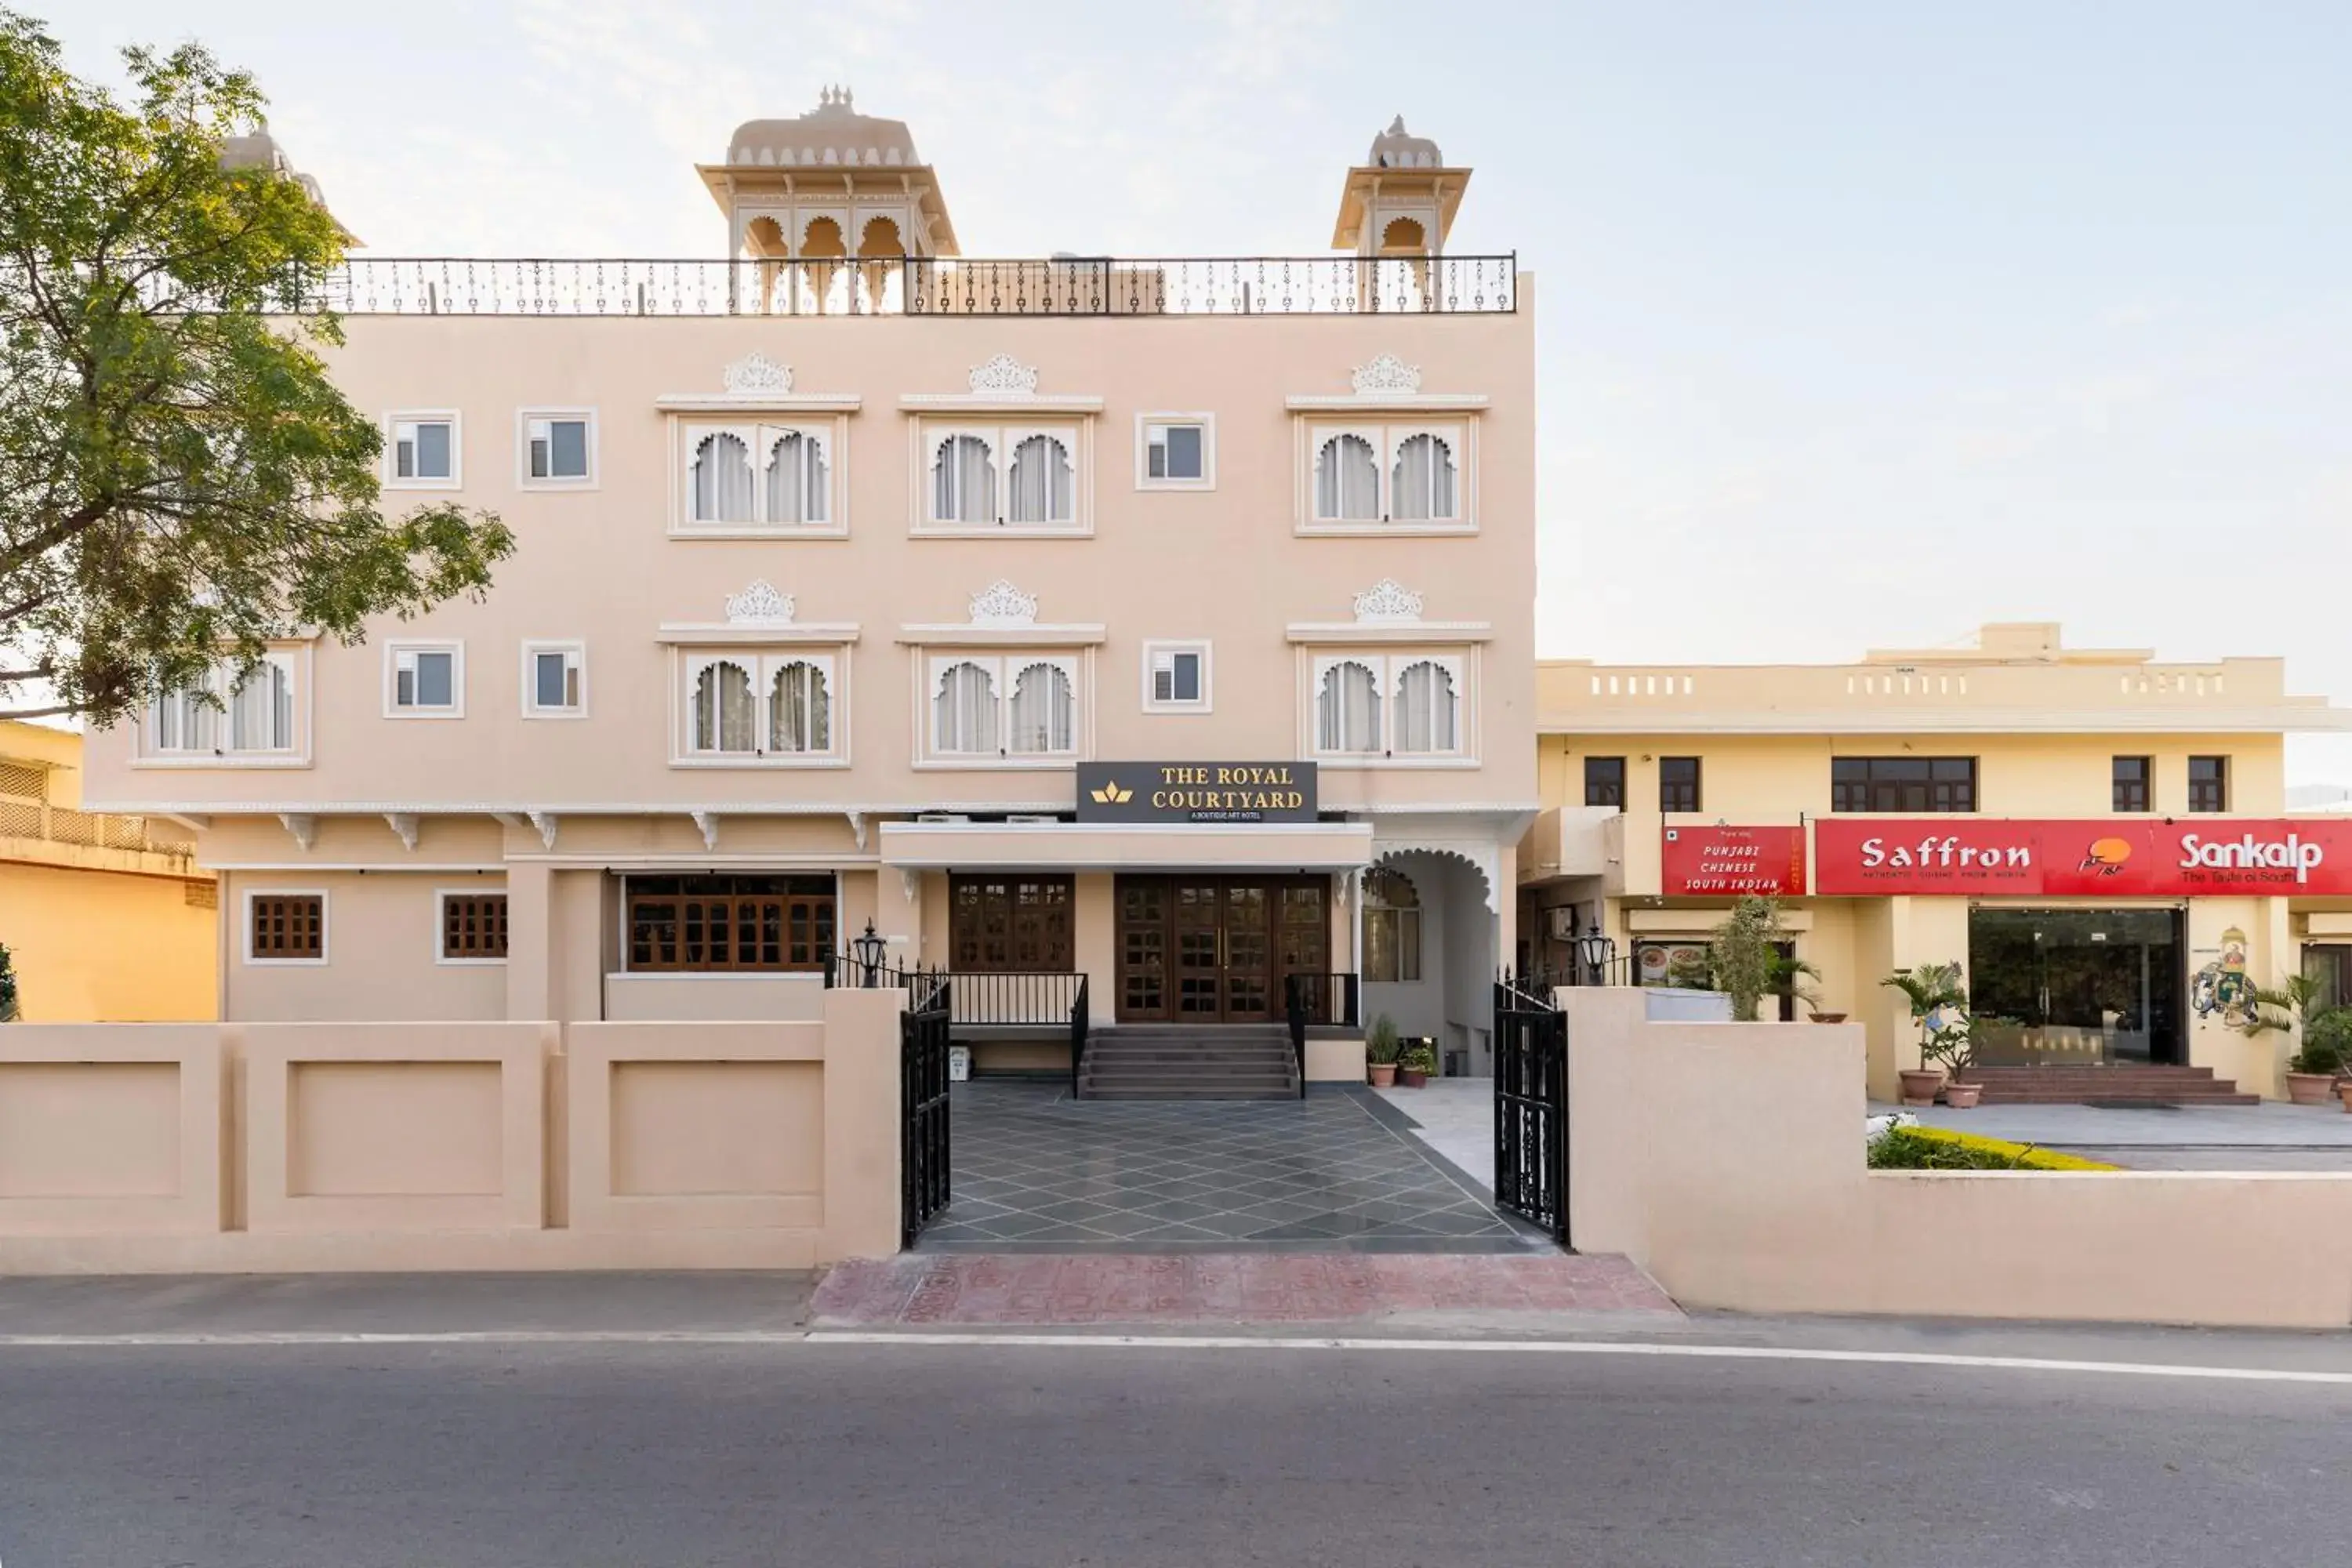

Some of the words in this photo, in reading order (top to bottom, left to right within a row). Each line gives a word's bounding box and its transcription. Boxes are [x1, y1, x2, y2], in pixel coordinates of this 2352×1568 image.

[1161, 768, 1210, 785] THE
[1217, 768, 1293, 785] ROYAL
[1152, 791, 1303, 809] COURTYARD
[1703, 846, 1760, 857] PUNJABI
[1860, 836, 2031, 867] Saffron
[2180, 833, 2324, 884] Sankalp
[1700, 862, 1757, 873] CHINESE
[1685, 878, 1726, 890] SOUTH
[1730, 878, 1779, 890] INDIAN
[2182, 871, 2206, 883] The
